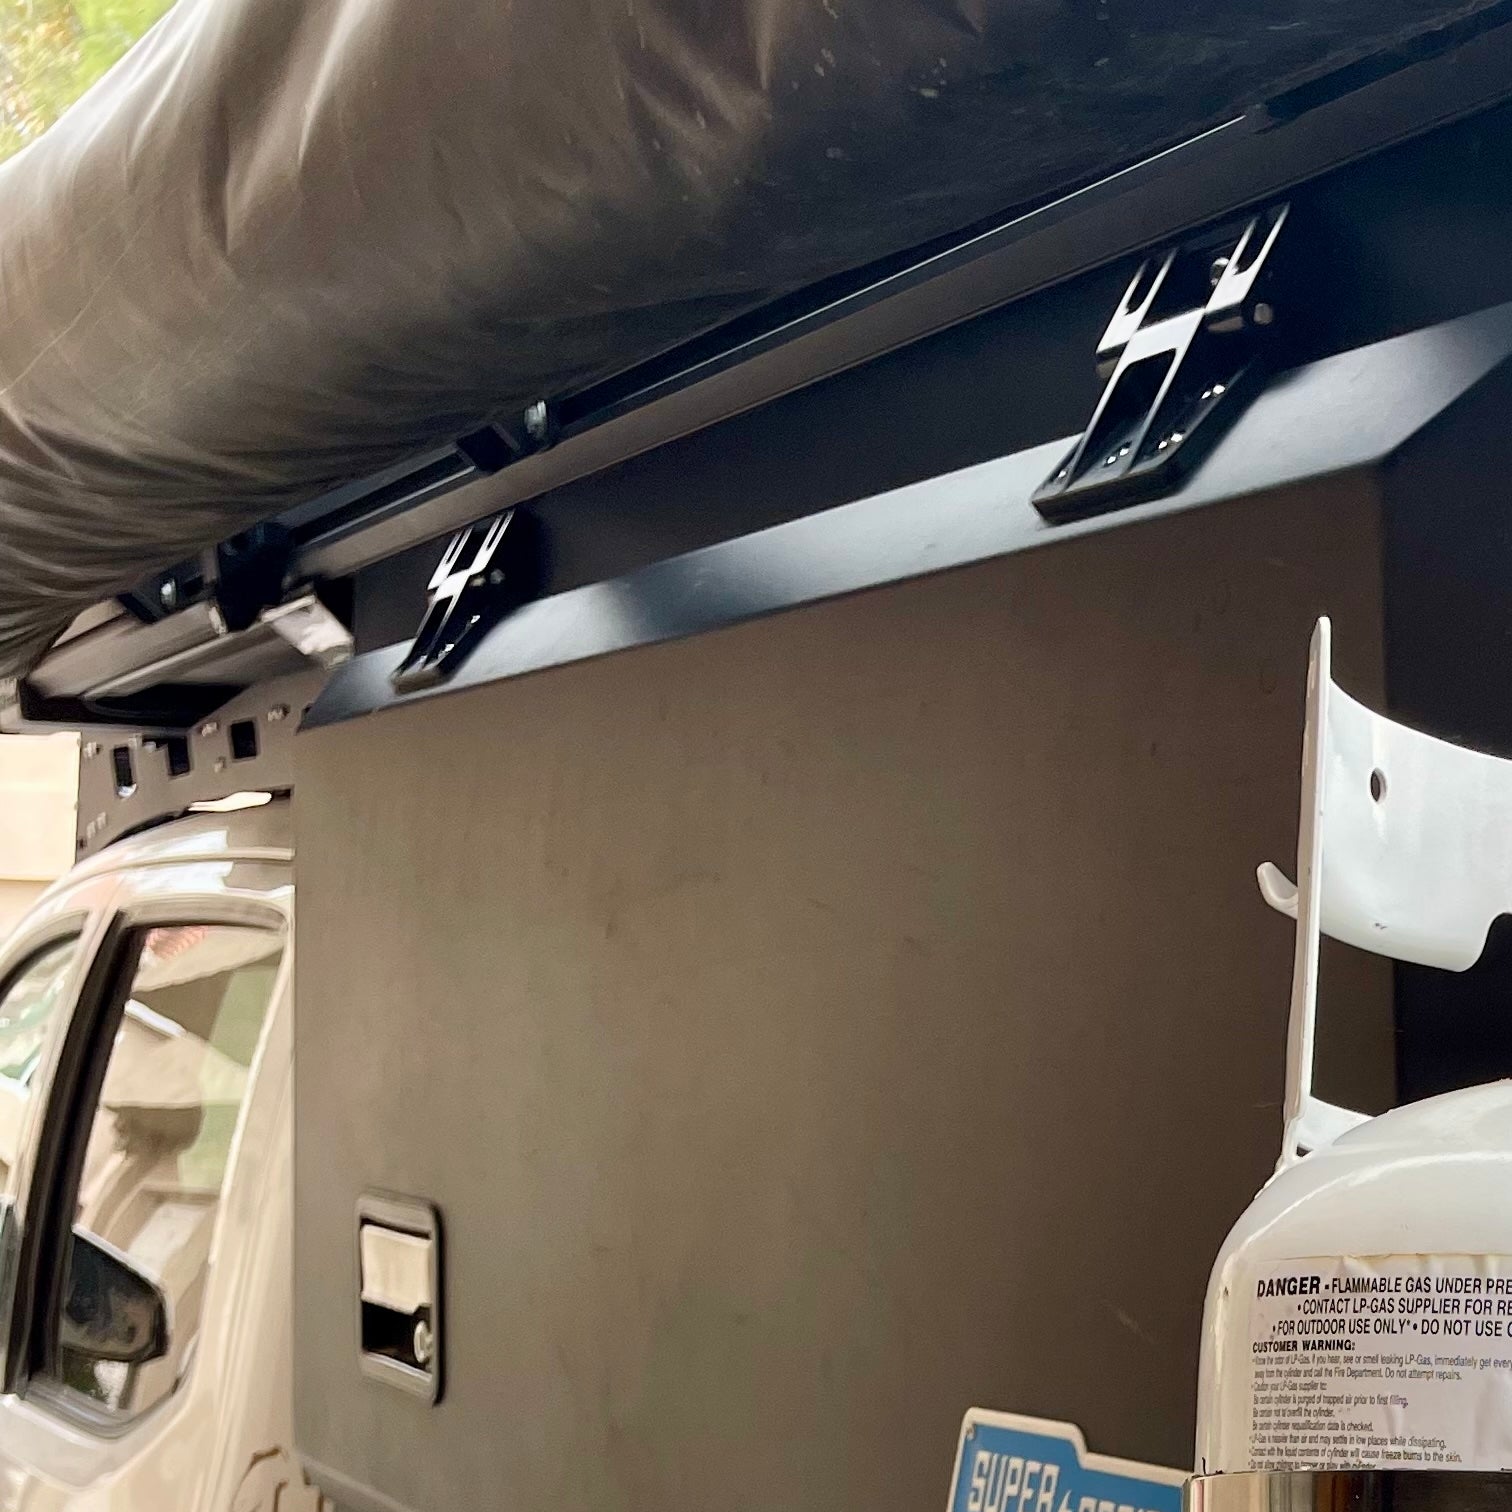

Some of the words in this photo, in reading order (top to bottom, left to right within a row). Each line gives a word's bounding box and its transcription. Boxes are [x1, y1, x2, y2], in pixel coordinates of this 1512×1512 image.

[1256, 1277, 1320, 1296] DANGER
[1332, 1277, 1401, 1293] FLAMMABLE
[1405, 1277, 1431, 1293] GAS
[1435, 1278, 1481, 1293] UNDER
[1302, 1298, 1349, 1314] CONTACT
[1352, 1298, 1394, 1313] LP-GAS
[1398, 1298, 1460, 1314] SUPPLIER
[1464, 1299, 1492, 1315] FOR
[1277, 1320, 1295, 1335] FOR
[1297, 1319, 1345, 1335] OUTDOOR
[1348, 1319, 1370, 1334] USE
[1421, 1320, 1439, 1334] DO
[1443, 1320, 1468, 1335] NOT
[1475, 1321, 1502, 1336] USE
[1252, 1340, 1297, 1353] CUSTOMER
[1302, 1339, 1355, 1351] WARNING:
